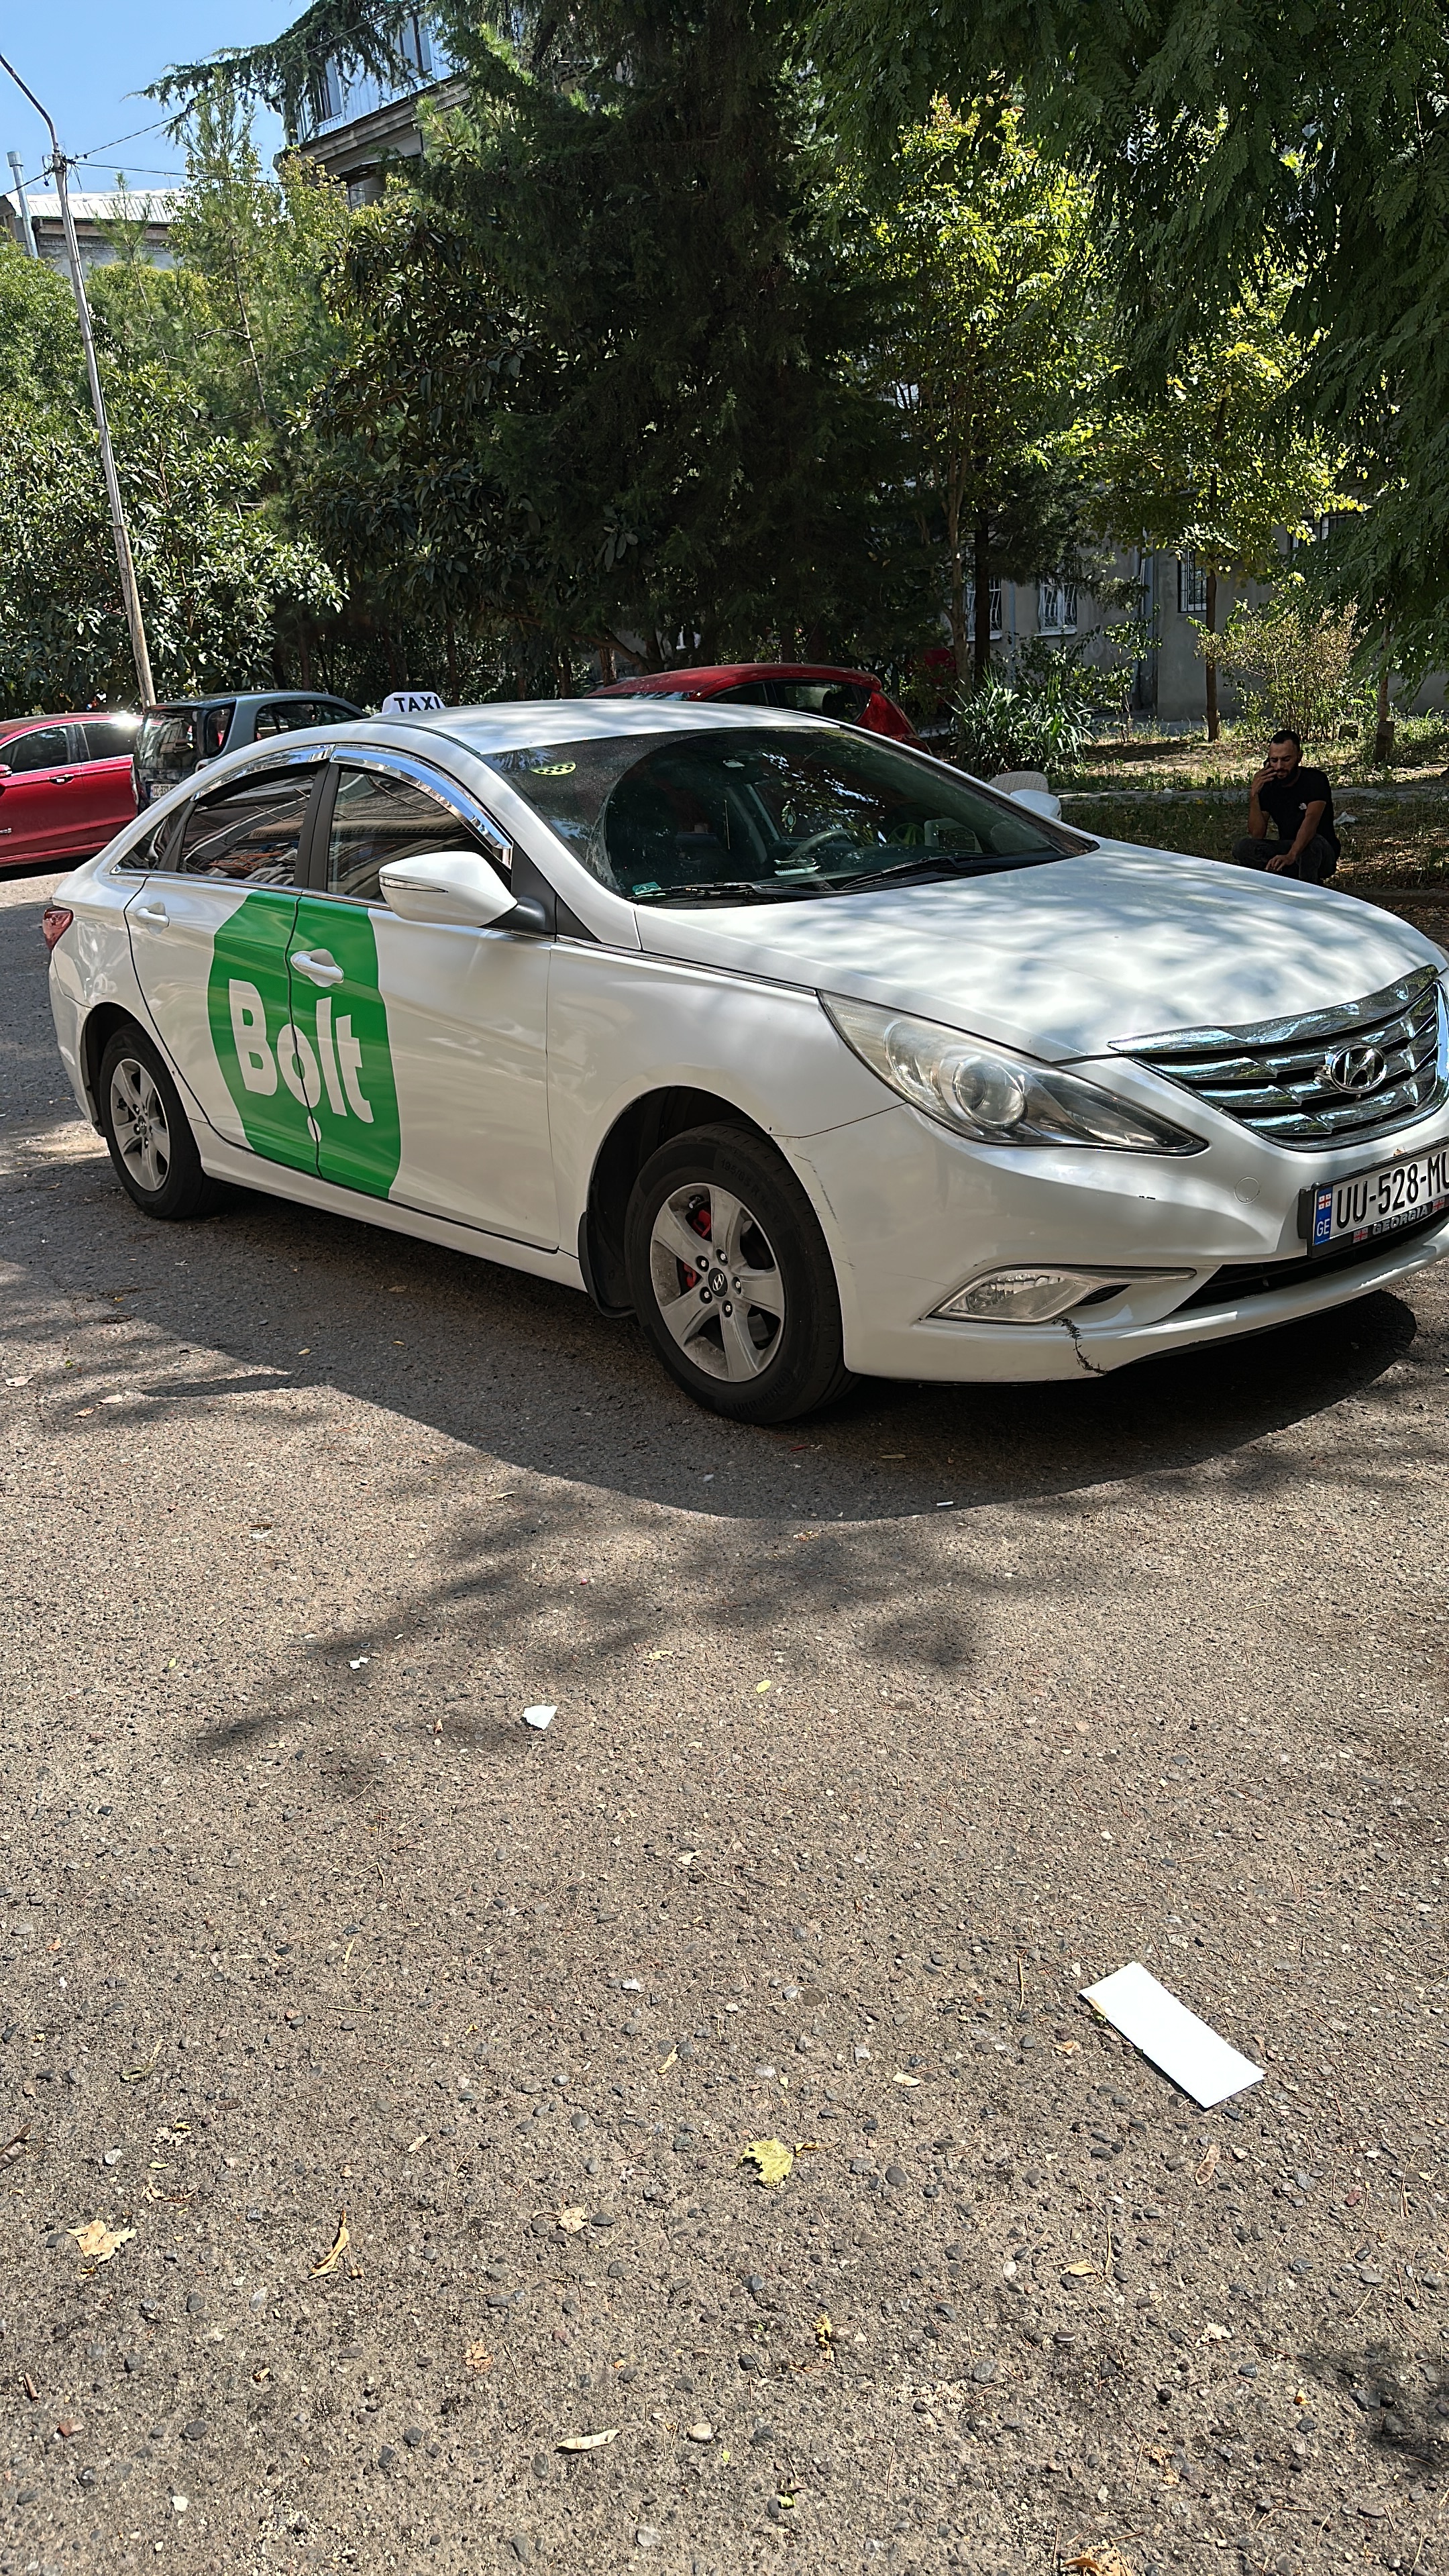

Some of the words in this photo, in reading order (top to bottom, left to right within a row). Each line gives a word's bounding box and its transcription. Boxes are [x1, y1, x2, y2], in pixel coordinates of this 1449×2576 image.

[394, 696, 441, 712] TAXI
[229, 978, 374, 1124] Bolt
[1316, 1218, 1330, 1237] GE
[1372, 1204, 1428, 1235] GEORGIA
